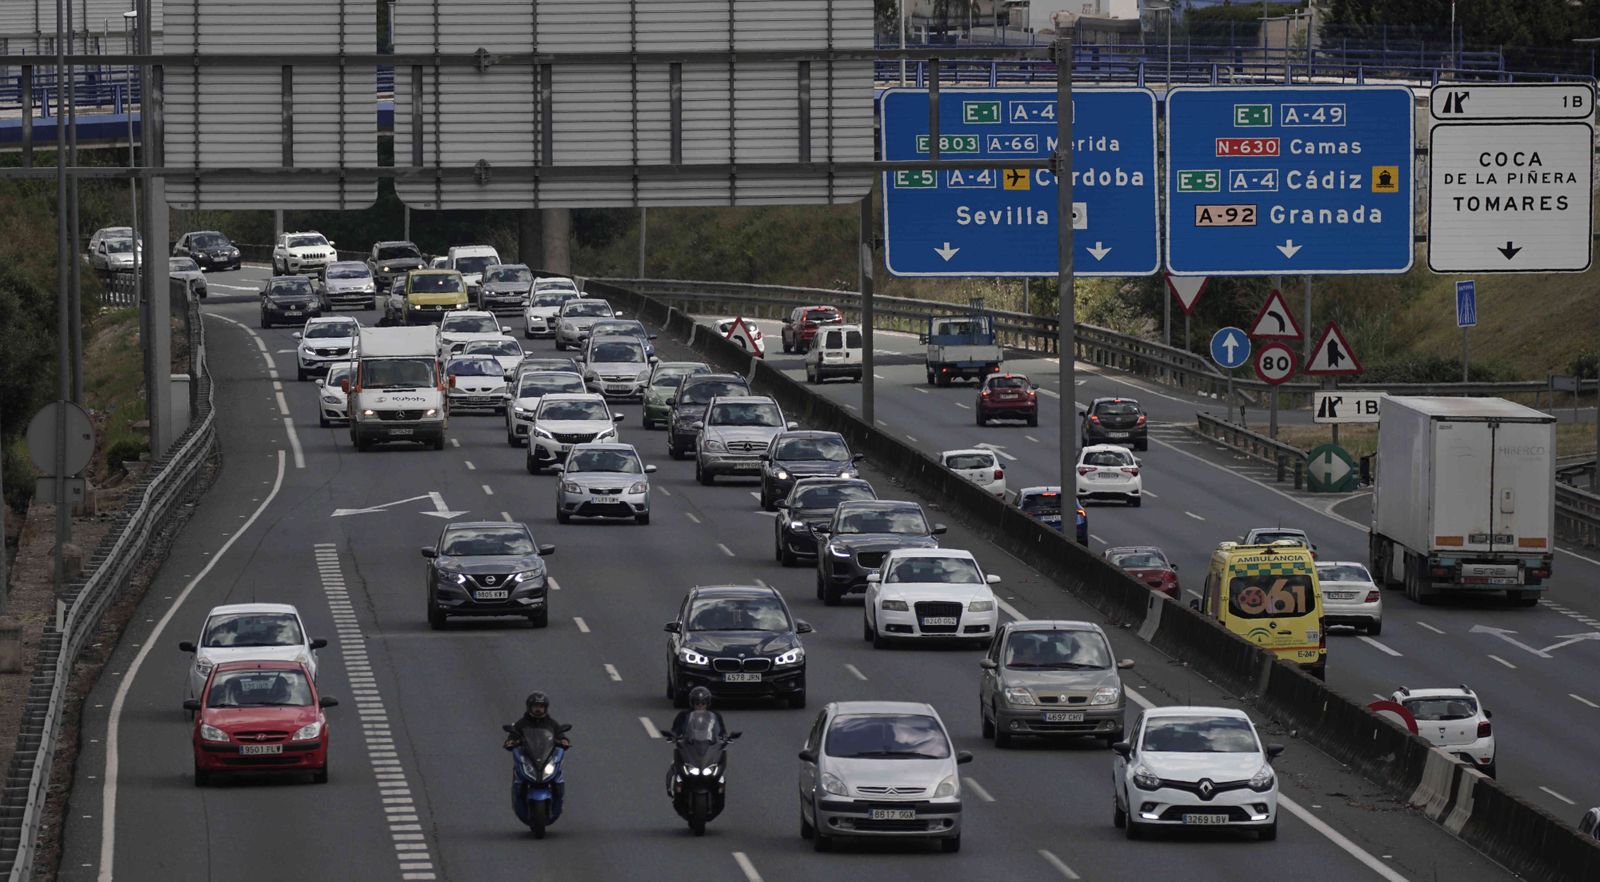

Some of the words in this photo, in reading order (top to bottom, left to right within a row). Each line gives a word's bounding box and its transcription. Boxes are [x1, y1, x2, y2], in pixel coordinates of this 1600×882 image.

[966, 104, 999, 120] E-1
[1013, 104, 1058, 120] A-4
[1237, 107, 1269, 124] E-1
[1284, 107, 1343, 123] A-49
[918, 137, 977, 150] E803
[990, 137, 1036, 150] A-66
[1046, 136, 1120, 152] Mrida
[1218, 141, 1278, 153] N-630
[1289, 138, 1362, 154] Camas
[1479, 151, 1543, 167] COCA
[897, 169, 934, 185] E-5
[950, 169, 992, 185] A-4
[1035, 167, 1145, 187] Crdoba
[1180, 173, 1217, 189] E-5
[1233, 173, 1275, 188] A-4
[1286, 169, 1362, 190] Cádiz
[1444, 173, 1467, 185] DE
[1476, 172, 1498, 185] LA
[1507, 170, 1577, 184] PIÑERA
[1453, 195, 1569, 211] TOMARES
[956, 206, 1049, 225] Sevilla
[1198, 208, 1254, 223] A-92
[1270, 204, 1382, 224] Granada
[1262, 356, 1290, 371] 80
[1237, 555, 1304, 563] AMBULANCIA
[1297, 650, 1317, 658] E-247
[1187, 815, 1209, 824] 3269
[1210, 815, 1227, 824] LBV
